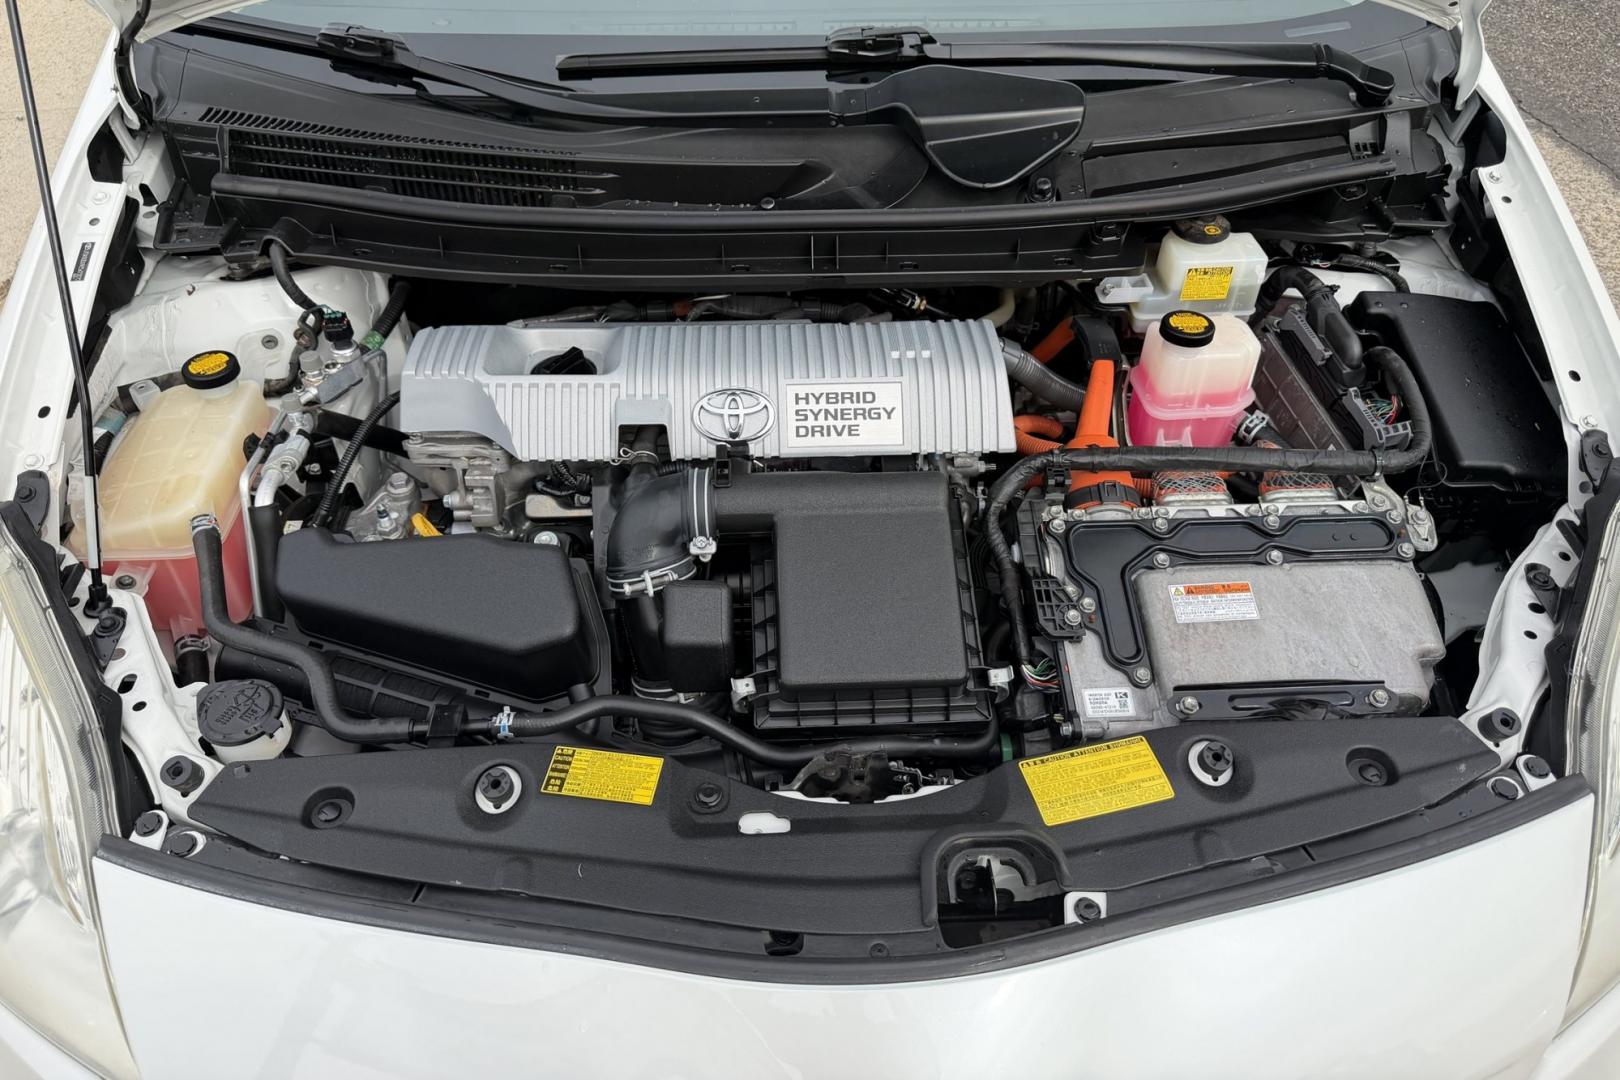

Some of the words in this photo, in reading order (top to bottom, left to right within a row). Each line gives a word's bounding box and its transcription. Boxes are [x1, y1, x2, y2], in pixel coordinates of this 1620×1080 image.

[795, 391, 876, 405] HYBRID
[795, 407, 896, 421] SYNERGY
[795, 424, 860, 438] DRIVE
[1045, 753, 1071, 763] CAUTION
[1075, 745, 1108, 757] ATTENTION
